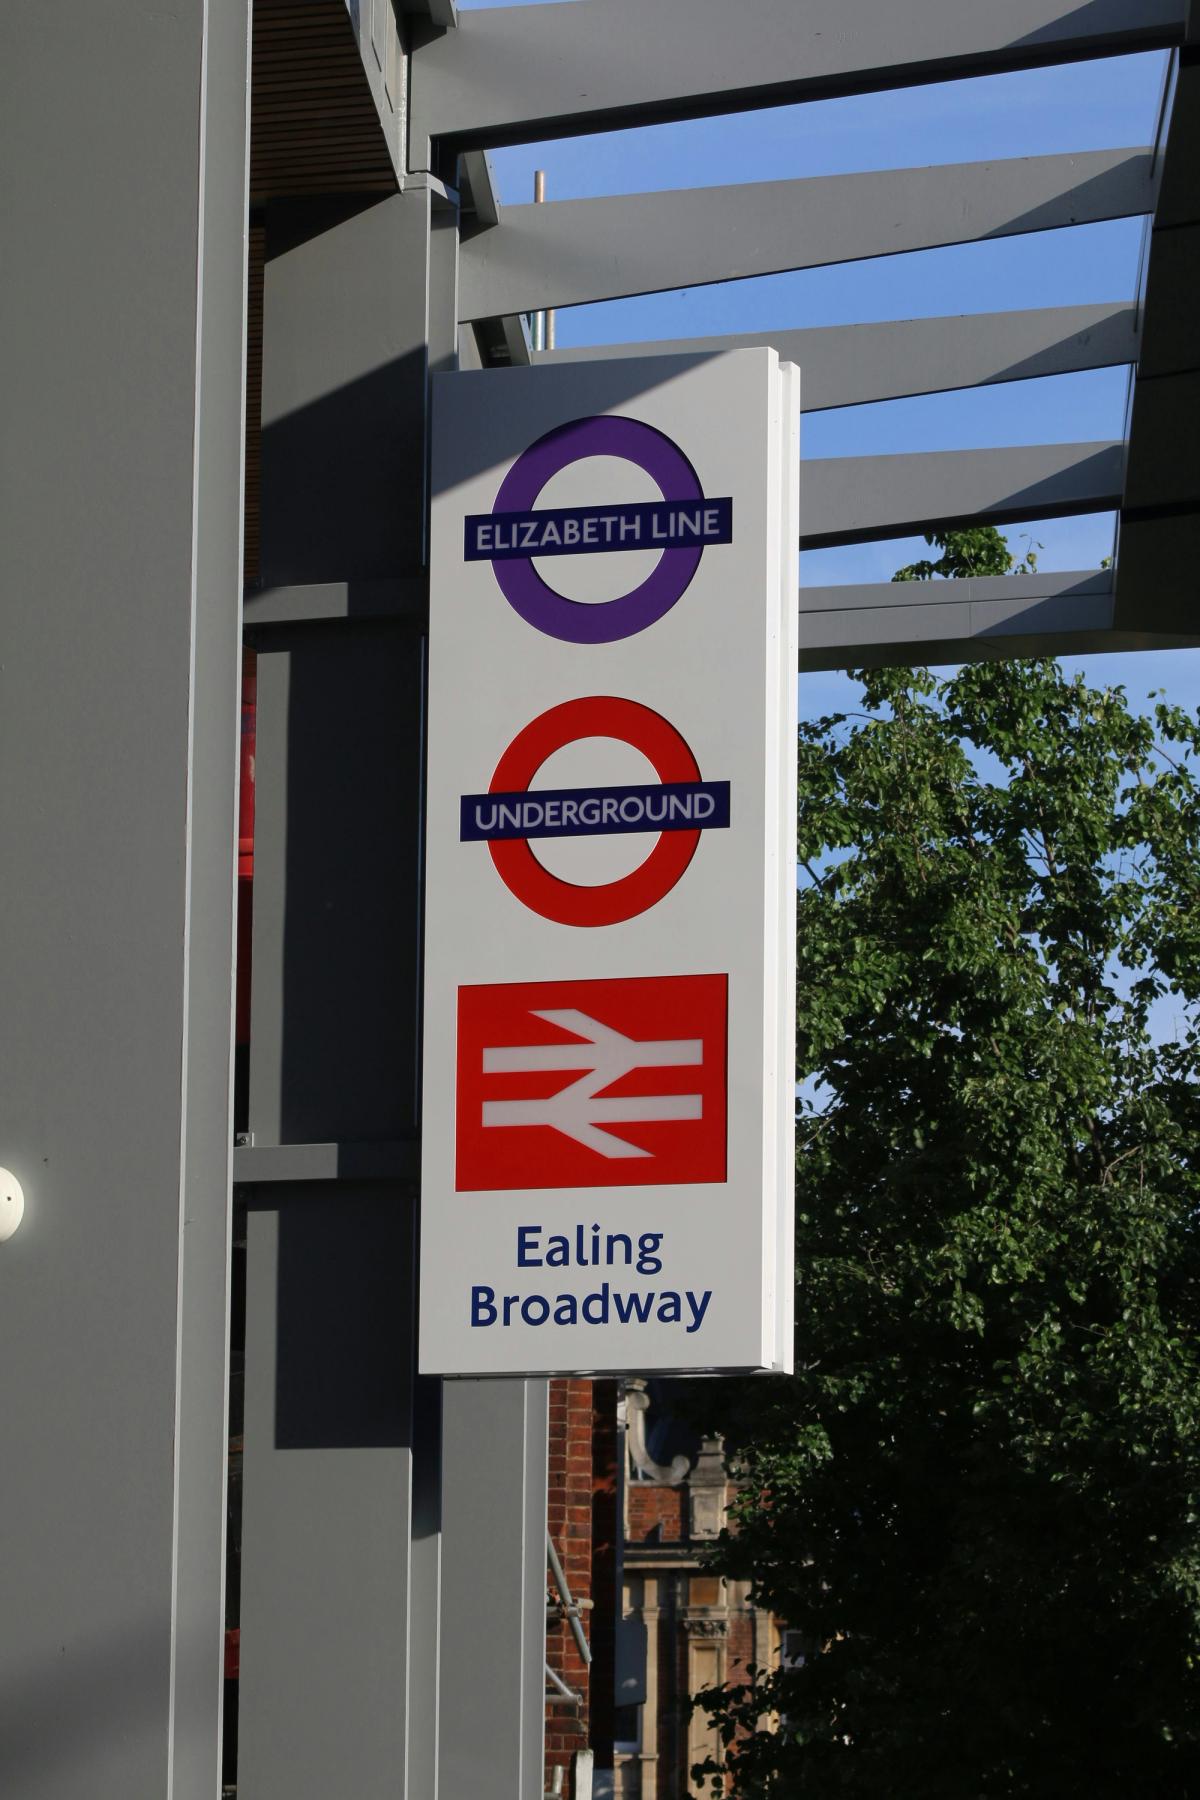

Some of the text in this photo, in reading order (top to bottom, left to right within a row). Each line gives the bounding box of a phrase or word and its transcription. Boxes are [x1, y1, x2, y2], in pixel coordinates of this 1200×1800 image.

[476, 509, 720, 551] ELIZABETH LINE
[475, 793, 715, 830] UNDERGROUND
[517, 1223, 664, 1275] Ealing
[471, 1282, 712, 1333] Broadway
